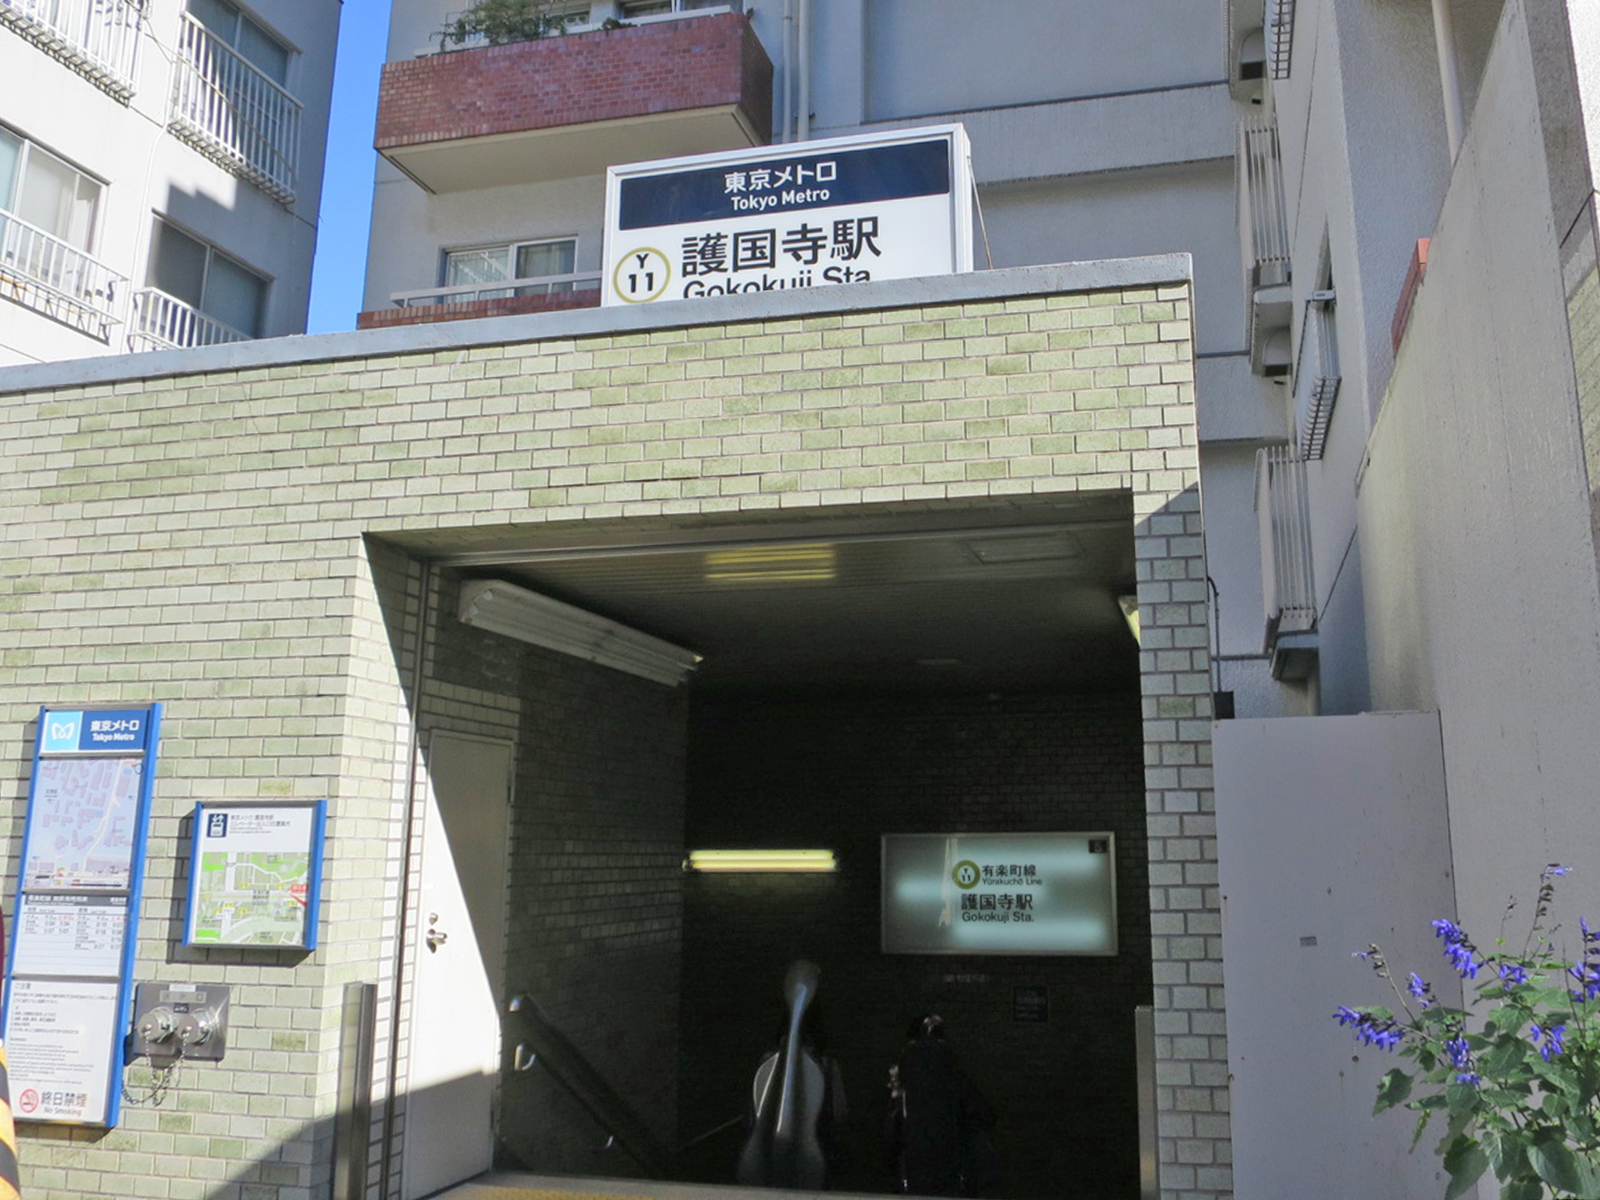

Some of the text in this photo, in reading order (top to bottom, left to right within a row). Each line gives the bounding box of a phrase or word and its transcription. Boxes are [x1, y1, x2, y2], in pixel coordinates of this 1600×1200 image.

[724, 160, 837, 196] 東京メトロ
[731, 188, 831, 212] Tokyo Metro
[681, 215, 882, 278] 護国寺駅
[636, 253, 650, 269] Y
[628, 273, 654, 293] 11
[90, 719, 139, 732] 東京メトロ
[92, 732, 135, 742] Tokyo Metro
[982, 864, 1037, 878] 有楽町線
[1026, 878, 1042, 886] Line
[961, 894, 1033, 910] 護国寺駅
[962, 912, 1035, 923] Gokokuji Sta.
[41, 1091, 87, 1107] 終日禁煙
[44, 1106, 82, 1116] No Smoking
